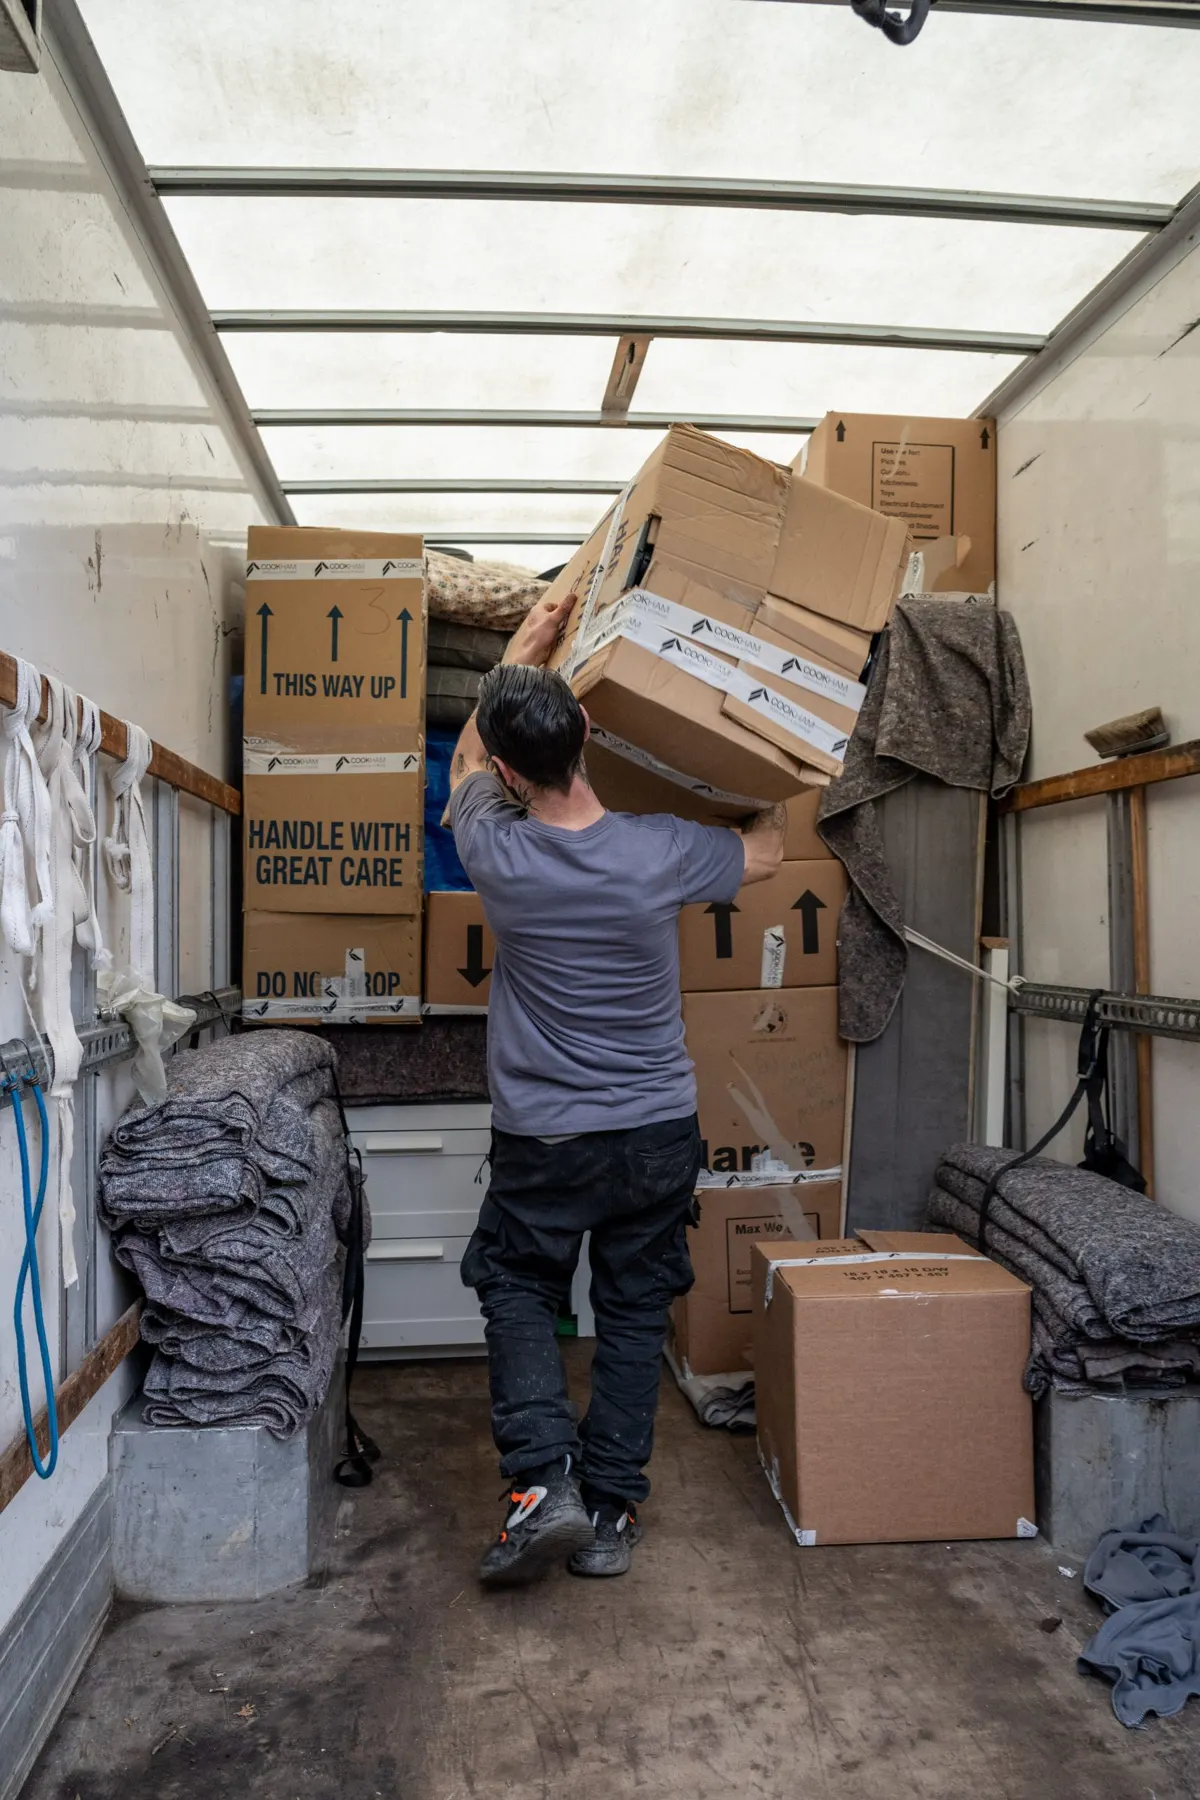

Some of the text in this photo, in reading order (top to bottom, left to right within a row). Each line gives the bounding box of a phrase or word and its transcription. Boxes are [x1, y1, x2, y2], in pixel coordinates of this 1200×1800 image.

[880, 489, 895, 498] Toys
[880, 500, 945, 509] Electrical Equipment
[713, 625, 763, 653] COOKHAM
[803, 665, 850, 694] COOKHAM
[273, 673, 396, 699] THIS WAY UP
[770, 696, 816, 730] COOKHAM
[249, 819, 411, 853] HANDLE WITH
[255, 855, 403, 887] GREAT CARE
[256, 971, 287, 998] DO
[363, 971, 401, 998] ROP
[700, 1139, 816, 1173] lare
[735, 1223, 761, 1235] Max
